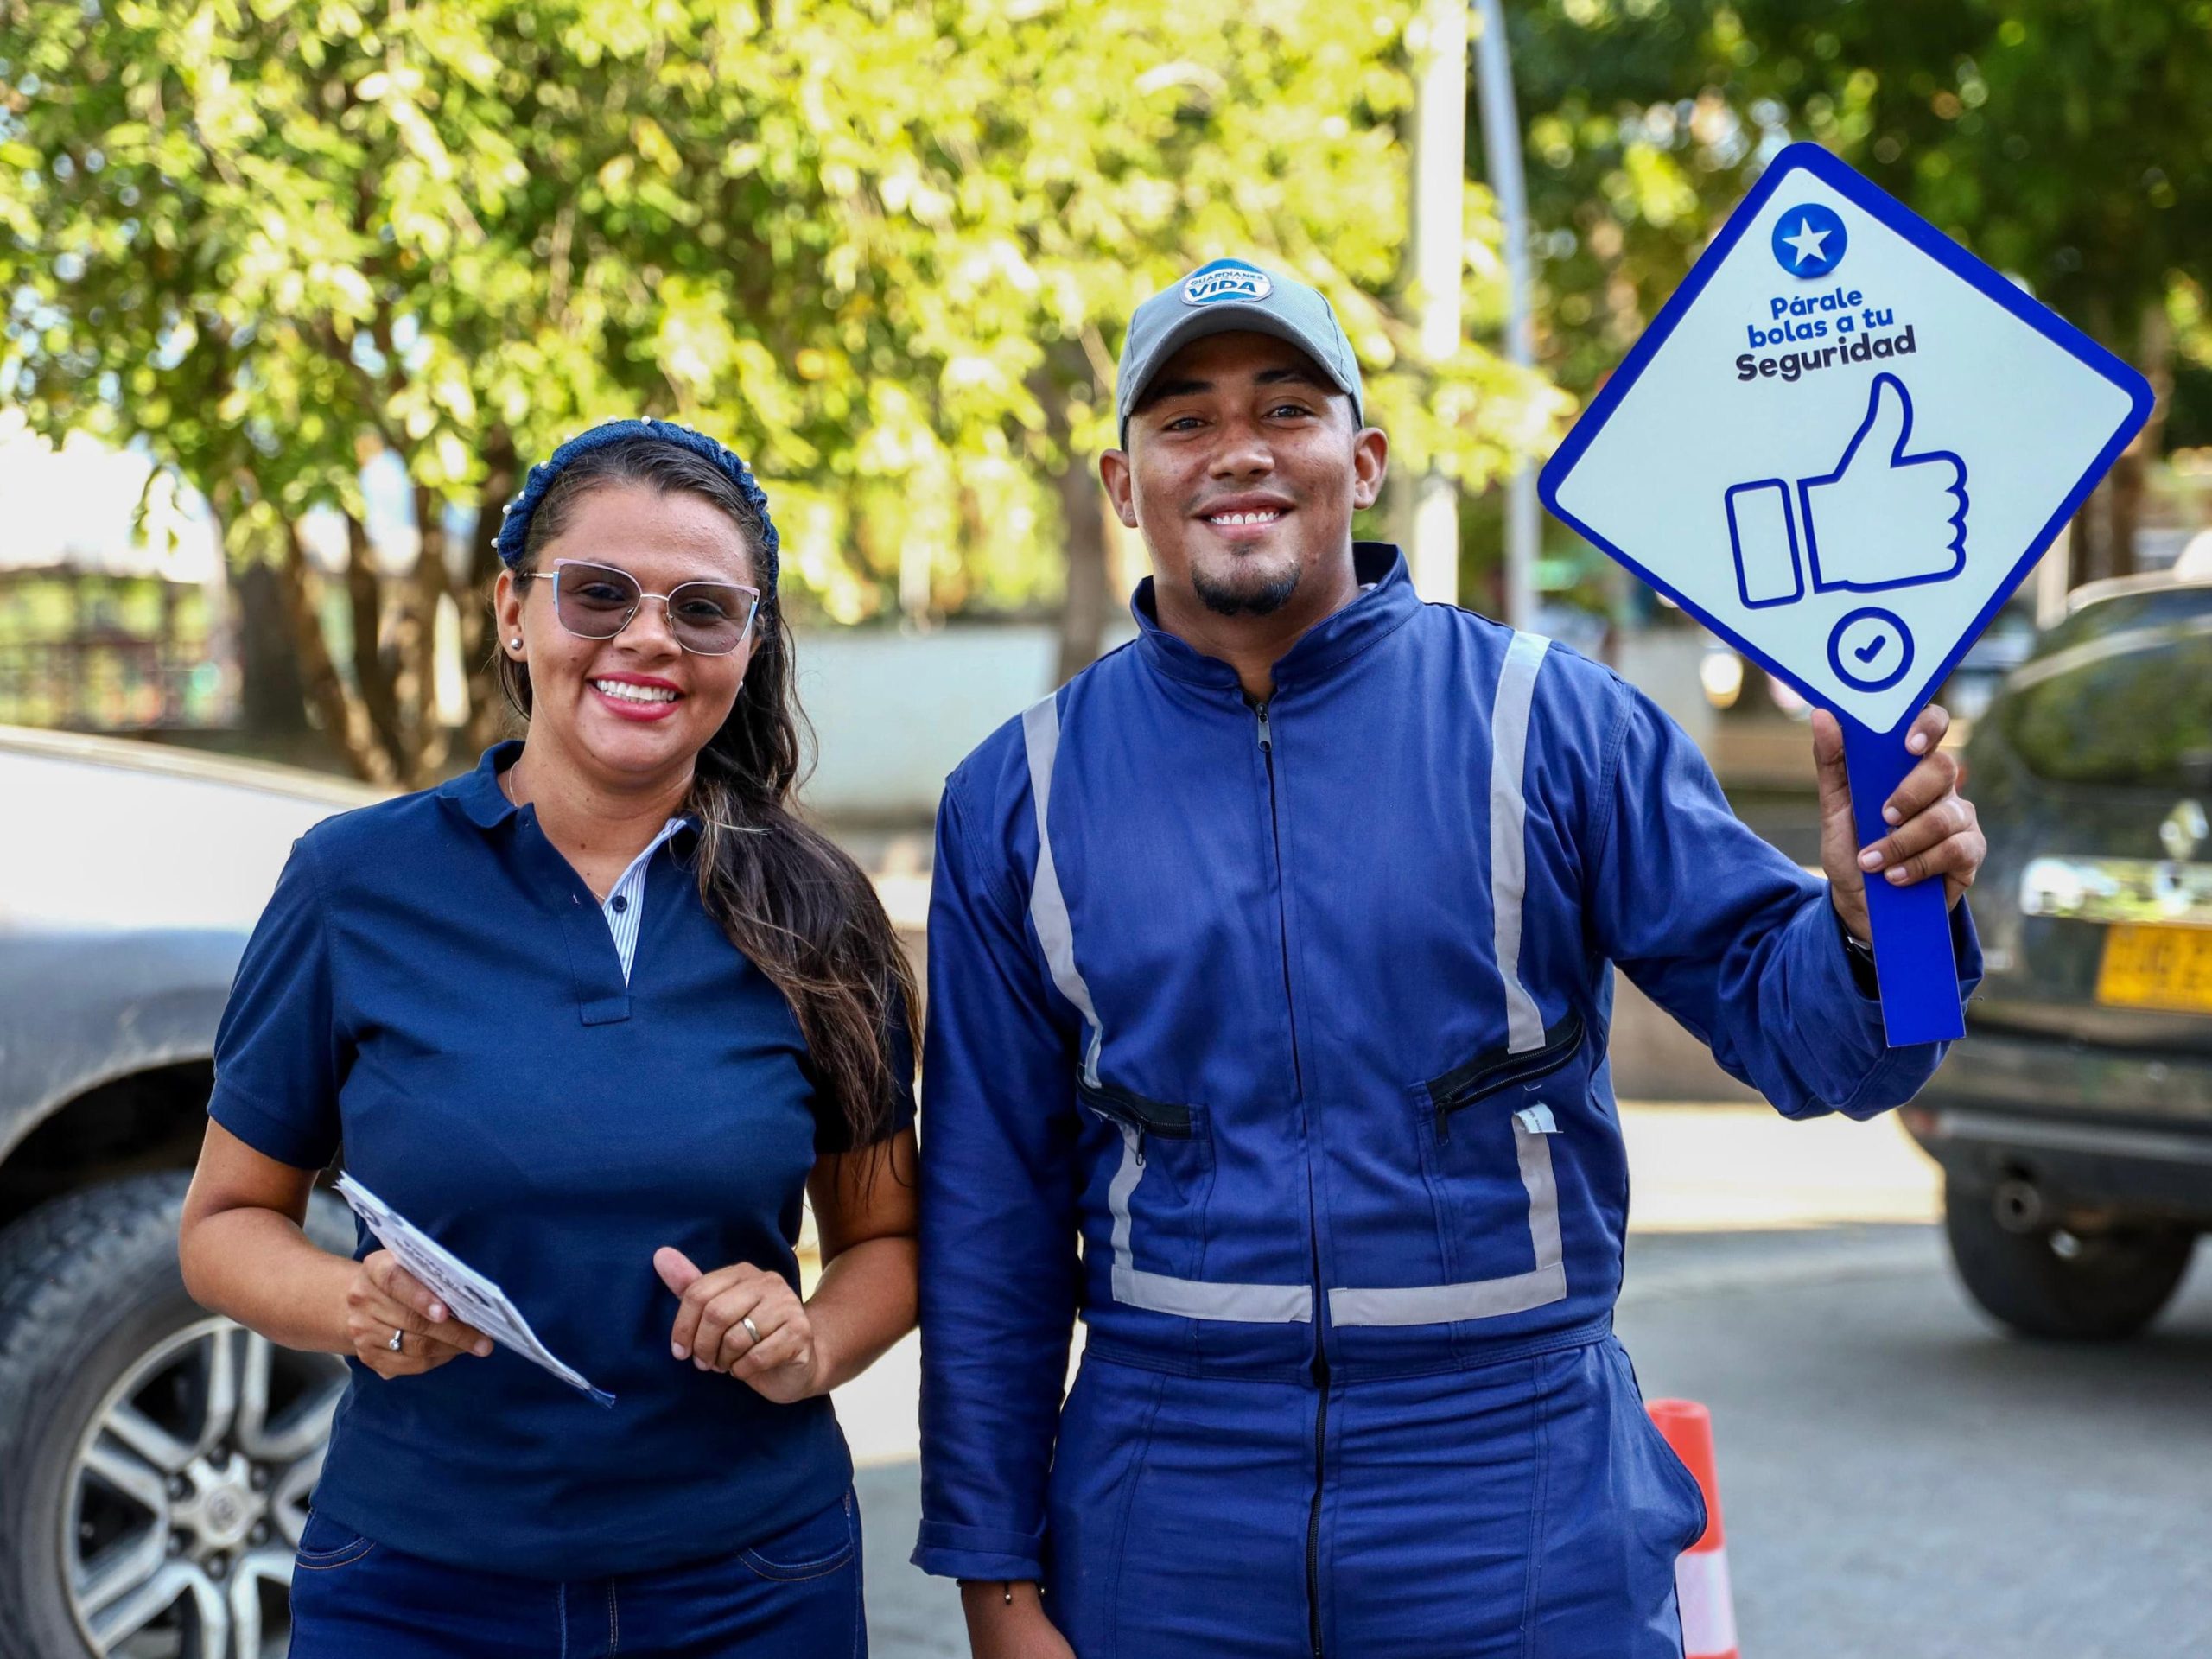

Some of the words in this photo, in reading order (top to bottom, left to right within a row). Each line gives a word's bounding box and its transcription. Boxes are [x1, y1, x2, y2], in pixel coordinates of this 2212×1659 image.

[1188, 280, 1256, 297] VIDA
[1770, 287, 1863, 320] Párale
[1747, 320, 1828, 349] bolas
[1836, 315, 1855, 333] a
[1862, 308, 1894, 329] tu
[1735, 324, 1916, 382] Seguridad
